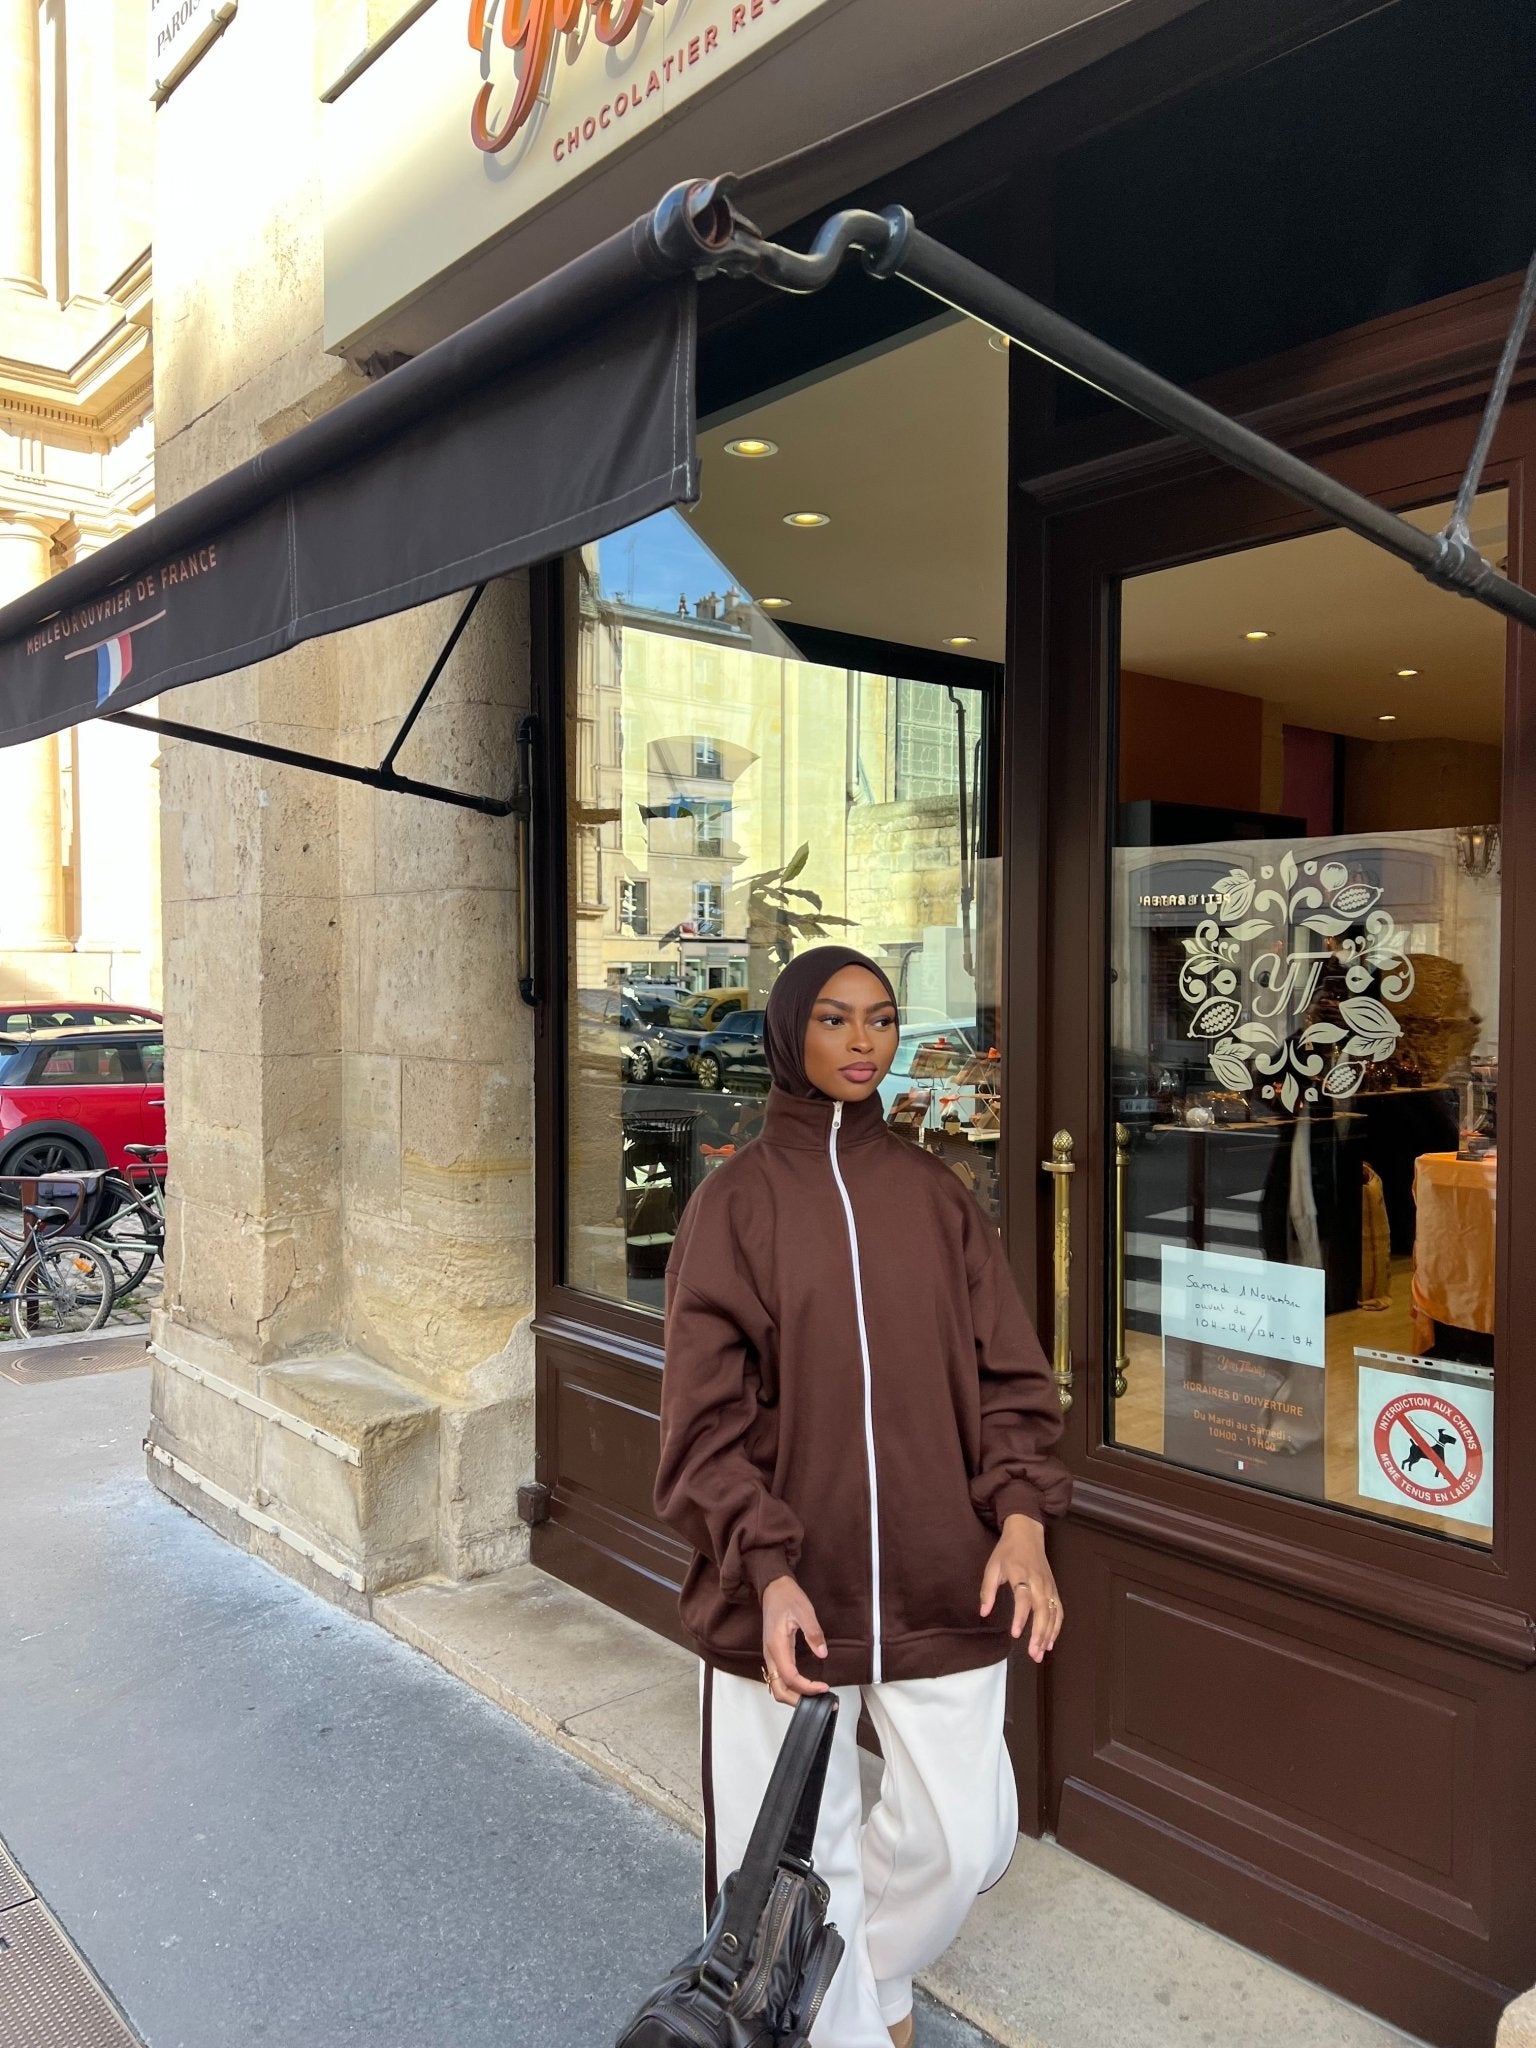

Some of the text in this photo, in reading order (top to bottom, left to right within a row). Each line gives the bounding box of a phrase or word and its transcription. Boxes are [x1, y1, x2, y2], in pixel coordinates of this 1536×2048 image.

[553, 25, 718, 161] CHOCOLATIER
[731, 0, 780, 33] RE
[26, 545, 217, 656] MEILLEUR OUVRIER DE FRANCE
[1239, 1285, 1246, 1297] 1
[1250, 1286, 1301, 1308] Novembre
[1183, 1381, 1230, 1400] HORAIRES
[1244, 1395, 1304, 1417] OUVERTURE
[1193, 1410, 1206, 1420] Du
[1208, 1413, 1234, 1427] Mardi
[1236, 1422, 1248, 1431] au
[1250, 1424, 1286, 1440] Samedi
[1209, 1427, 1236, 1442] 10H00
[1247, 1436, 1276, 1452] 19H00
[1379, 1397, 1477, 1450] INTERDICTION AUX CHIENS
[1380, 1453, 1477, 1502] MEME TENUS EN LAISSE
